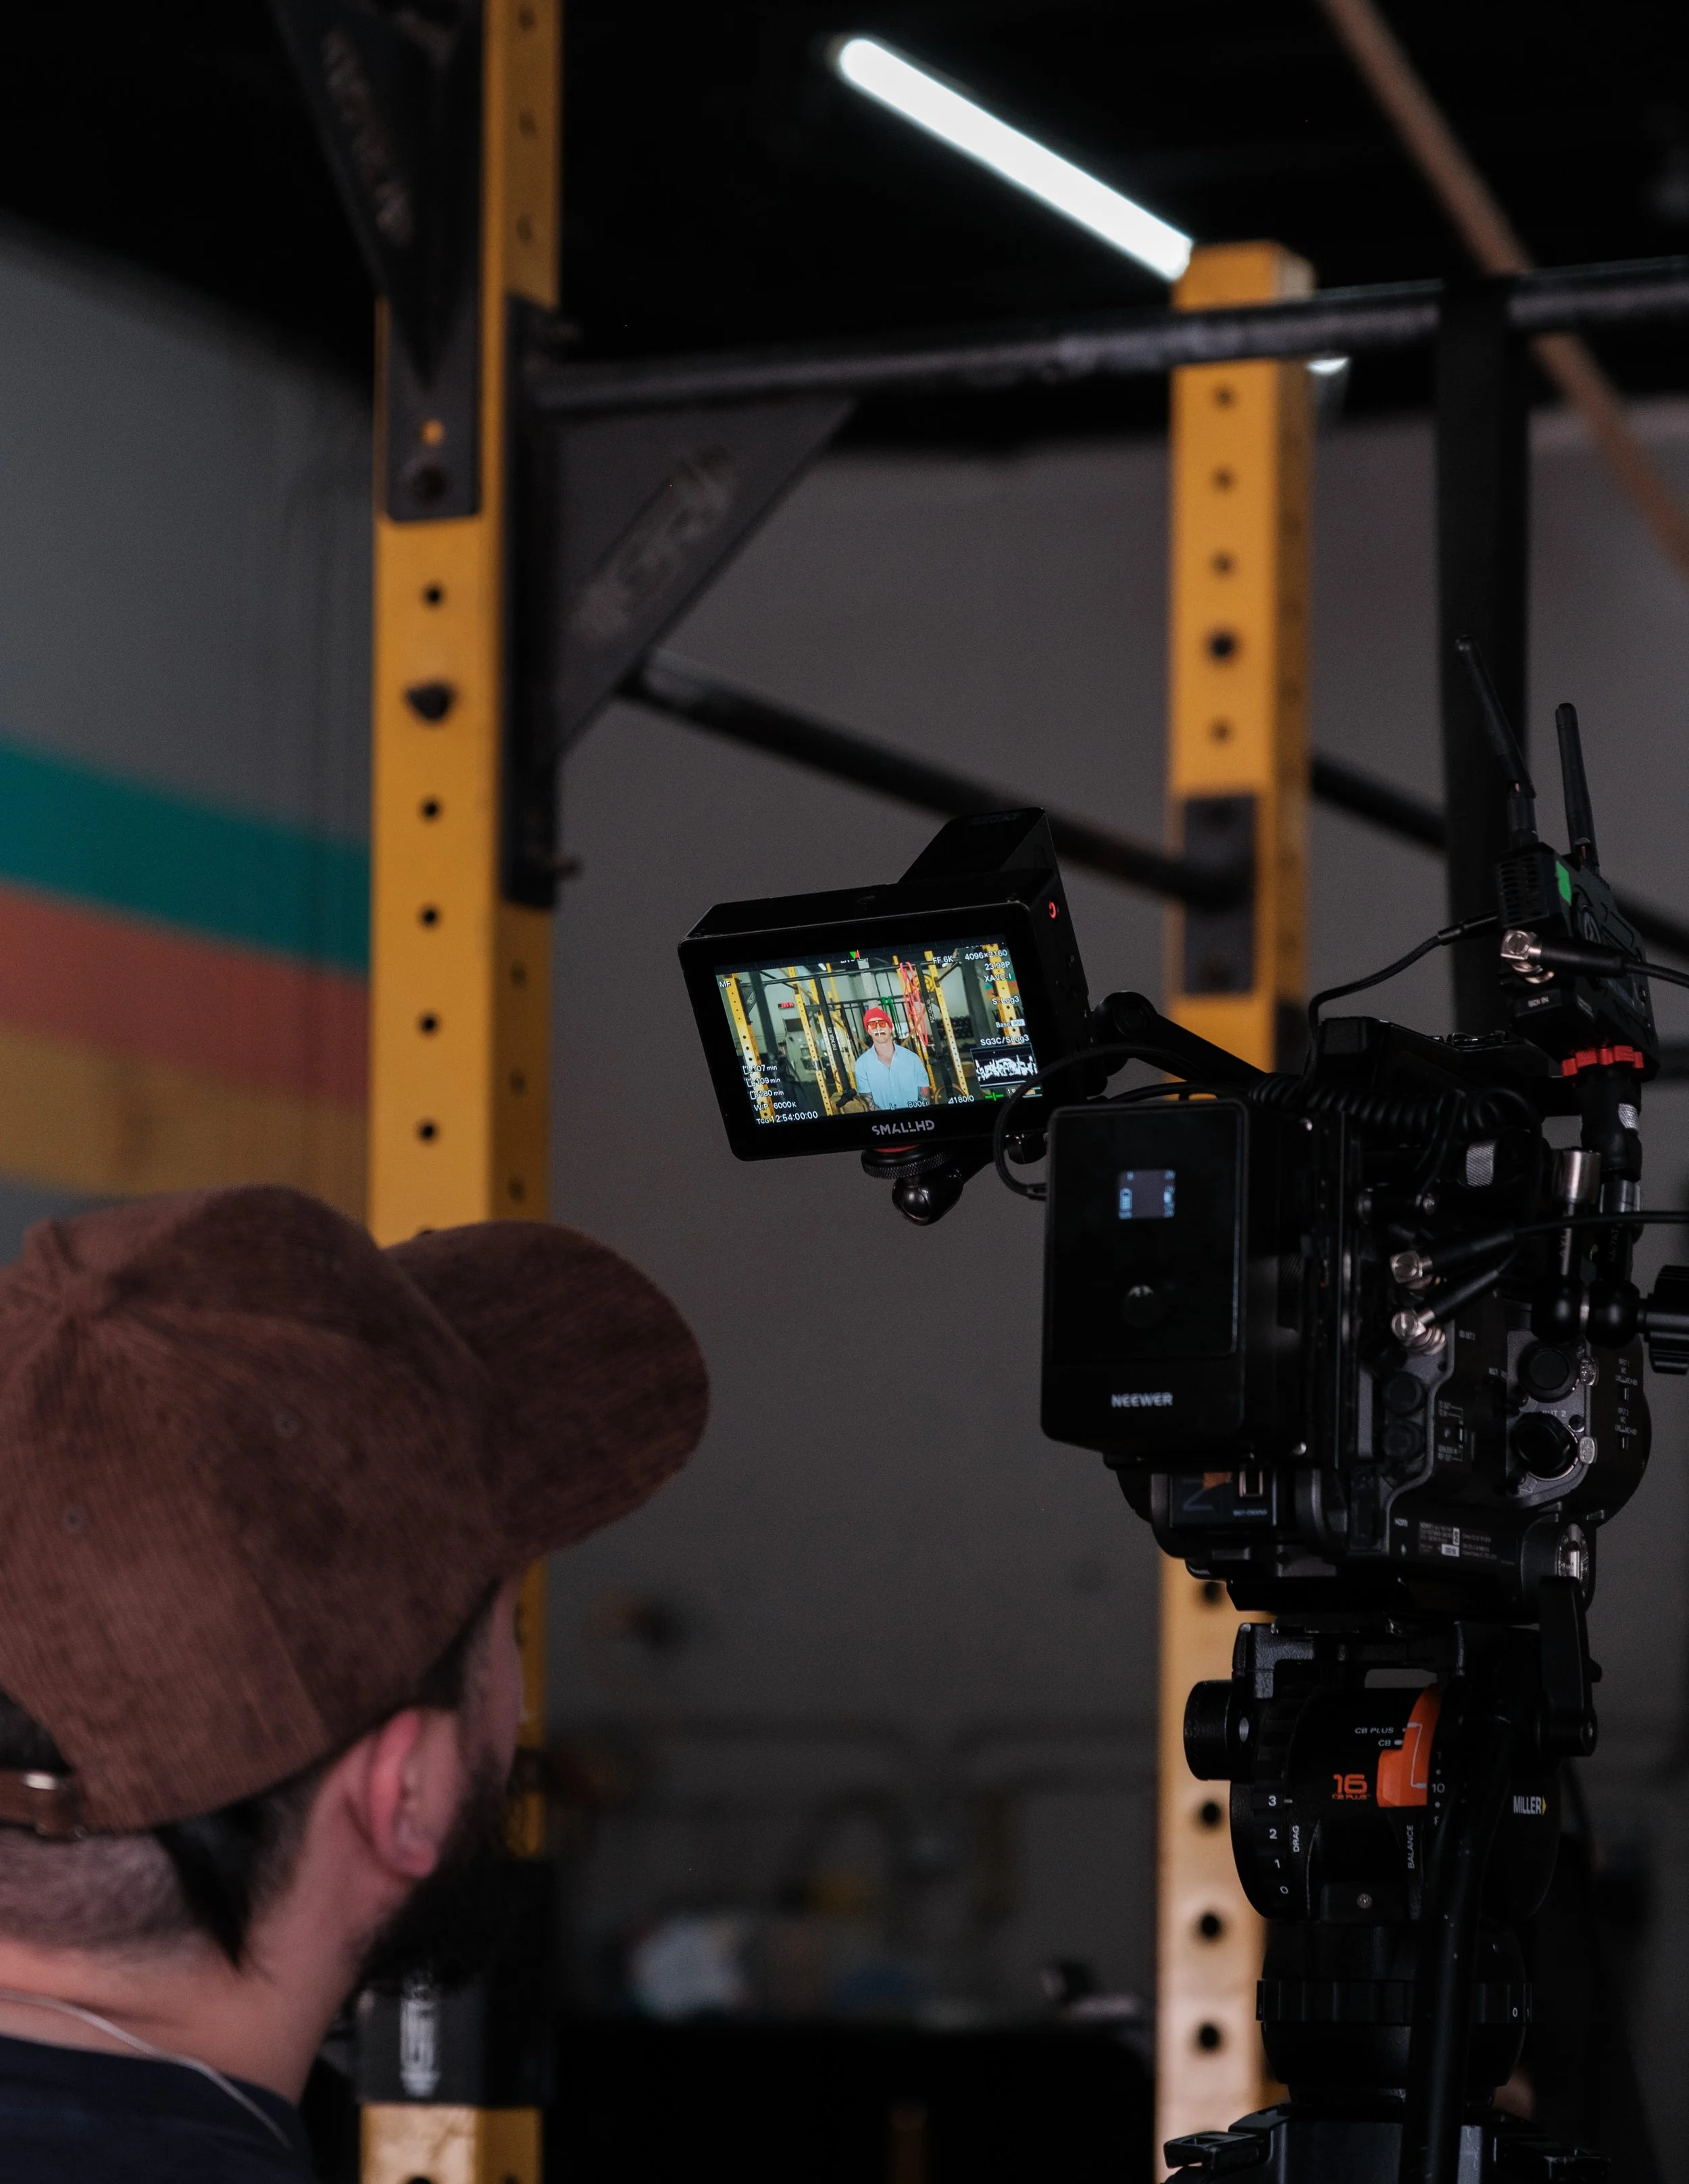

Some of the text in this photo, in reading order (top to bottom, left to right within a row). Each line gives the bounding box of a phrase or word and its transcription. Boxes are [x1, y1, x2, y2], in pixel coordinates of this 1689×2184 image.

[943, 956, 954, 964] 6K
[984, 973, 1012, 982] XAVC-I
[770, 1111, 818, 1123] 12:54:00:00
[872, 1120, 935, 1135] SMALLHD
[1111, 1392, 1174, 1408] NEEWER
[1355, 1727, 1367, 1735] CB
[1378, 1739, 1392, 1747] CB
[1332, 1773, 1368, 1795] 16
[1431, 1783, 1446, 1793] 10
[1268, 1795, 1277, 1807] 3
[1513, 1795, 1542, 1815] MILLER
[1269, 1828, 1278, 1839] 2
[1292, 1825, 1301, 1853] DRAG
[1407, 1825, 1416, 1870] BALANCE
[1274, 1858, 1281, 1869] 1
